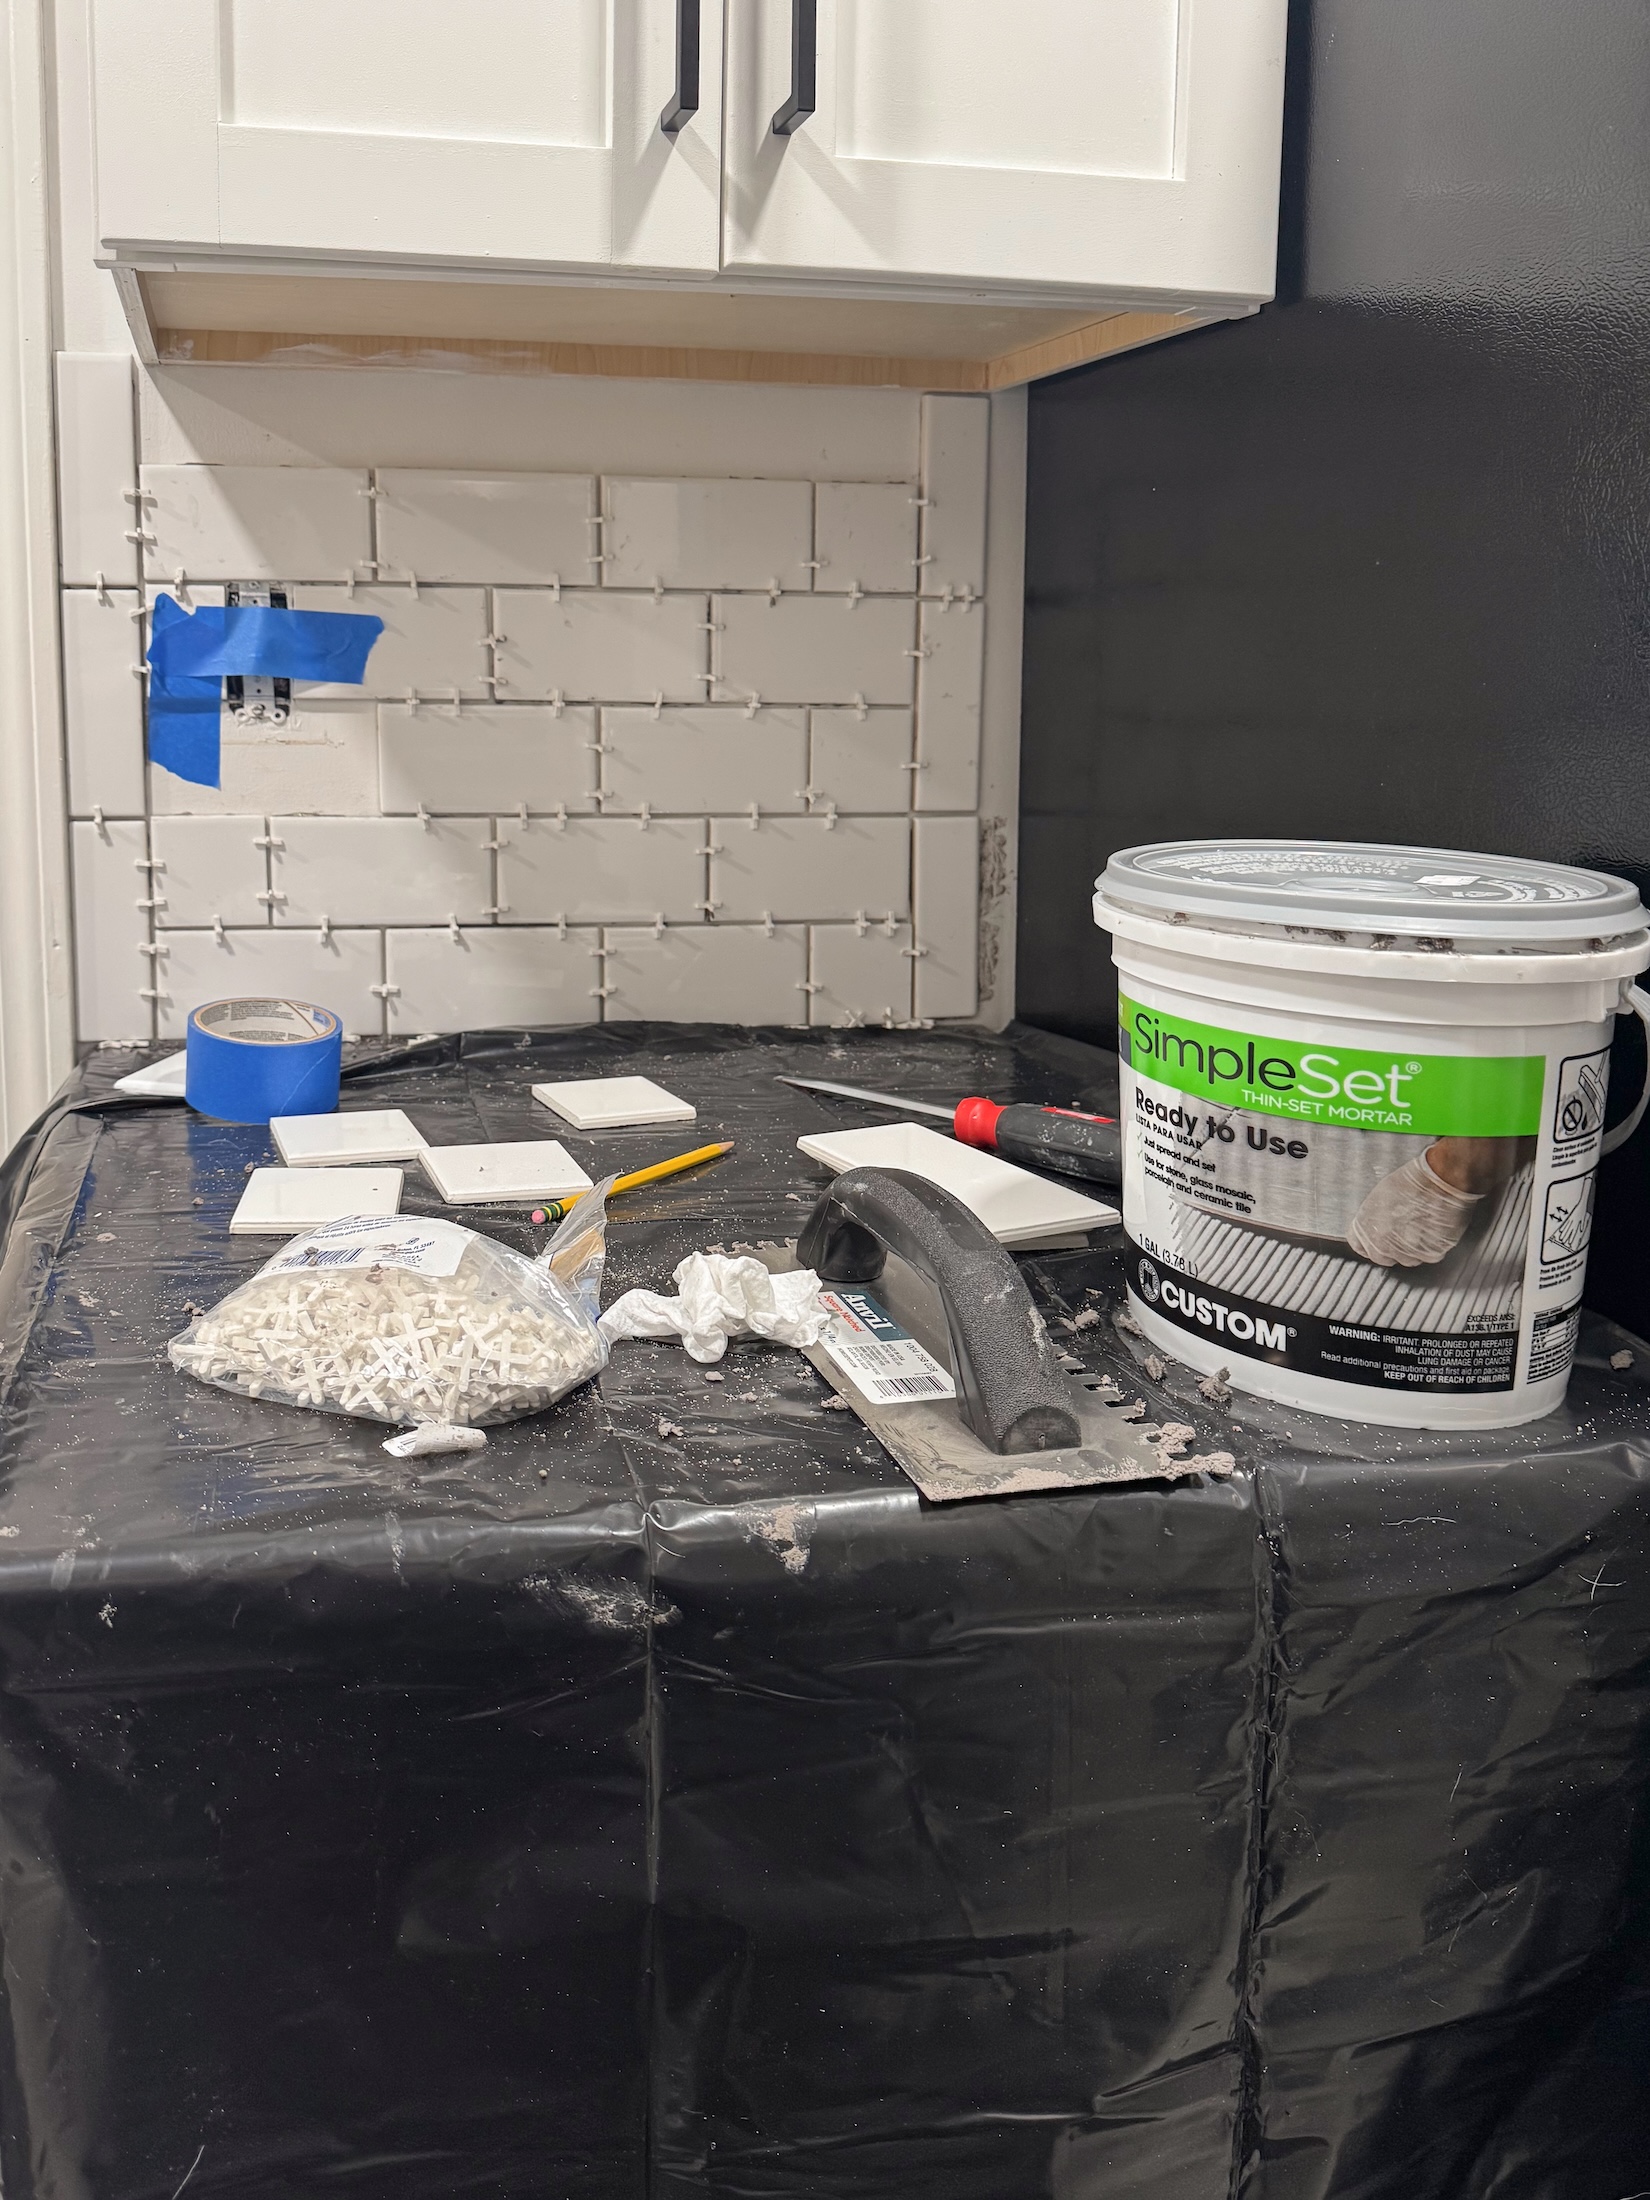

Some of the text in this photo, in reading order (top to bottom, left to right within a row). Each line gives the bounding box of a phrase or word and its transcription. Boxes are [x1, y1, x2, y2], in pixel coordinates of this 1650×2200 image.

[1135, 1086, 1309, 1159] Ready to Use
[1241, 1088, 1413, 1126] THIN-SET MORTAR
[1135, 1112, 1203, 1151] LISTA PARA USAR
[1143, 1135, 1216, 1173] Just spread and set
[1144, 1152, 1257, 1205] Use for stone, glass mosaic,
[1144, 1166, 1252, 1214] porcelain and ceramic tile
[1139, 1233, 1199, 1280] 1 GAL (3.78 L)
[823, 1295, 844, 1312] Square
[839, 1311, 866, 1333] Notched
[840, 1292, 894, 1330] Anvil
[1467, 1314, 1498, 1323] EXCEEDS
[1328, 1324, 1514, 1349] WARNING: IRRITANT. PROLONGED OR REPEATED
[1395, 1345, 1513, 1358] INHALATION OF DUST MAY CAUSE
[1320, 1350, 1341, 1362] Read
[1342, 1355, 1381, 1369] additional
[1382, 1362, 1428, 1374] precautions
[1429, 1367, 1444, 1375] and
[1445, 1366, 1461, 1375] first
[1461, 1367, 1472, 1375] aid
[1383, 1371, 1511, 1384] KEEP OUT OF REACH OF CHILDREN
[1417, 1356, 1439, 1366] LUNG
[1440, 1357, 1472, 1366] DAMAGE
[1473, 1357, 1484, 1366] OR
